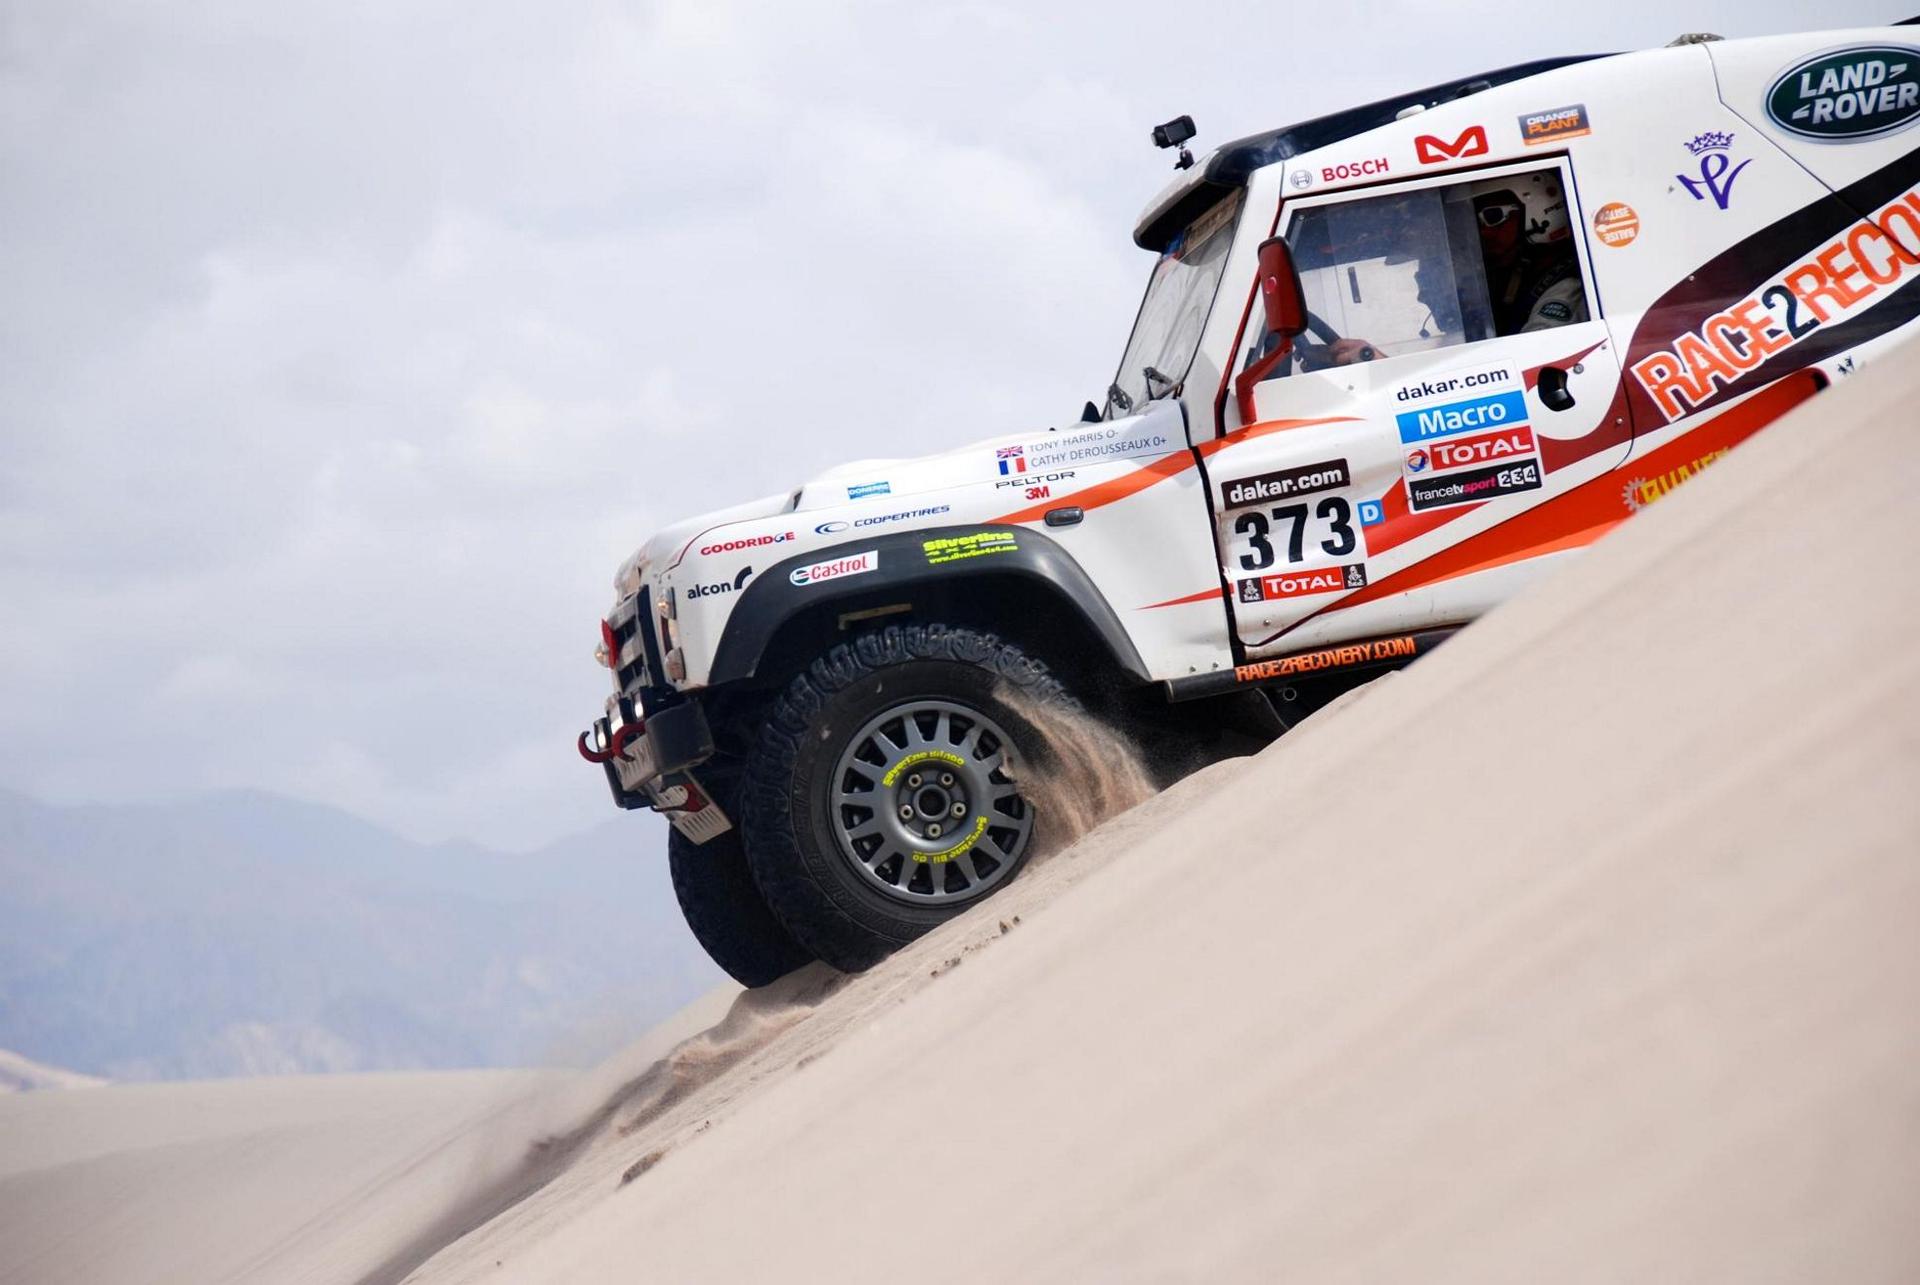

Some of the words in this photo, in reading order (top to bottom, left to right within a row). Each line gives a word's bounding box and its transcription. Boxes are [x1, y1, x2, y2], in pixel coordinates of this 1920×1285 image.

[1800, 60, 1886, 99] LAND
[1812, 81, 1919, 125] ROVER
[1527, 116, 1579, 136] PLANT
[1321, 157, 1389, 182] BOSCH
[1397, 368, 1509, 401] dakar.com
[1418, 403, 1506, 435] Macro
[1030, 438, 1058, 452] TONY
[1062, 430, 1103, 447] HARRIS
[1031, 452, 1067, 468] CATHY
[1070, 438, 1153, 461] DEROUSSEAUX
[1434, 436, 1531, 465] TOTAL
[996, 471, 1076, 489] PELTOR
[1230, 469, 1342, 503] dakar.com
[1415, 476, 1497, 502] francetvsport
[1498, 465, 1537, 487] 234
[1025, 486, 1050, 500] 3M
[854, 504, 951, 528] COOPERTIRES
[1362, 504, 1379, 523] D
[700, 531, 796, 556] GOODRIDGE
[1235, 496, 1356, 571] 373
[812, 555, 868, 580] Castrol
[687, 582, 732, 600] alcon
[1266, 574, 1341, 594] TOTAL
[1234, 636, 1416, 682] RACE2RECOVERY.COM
